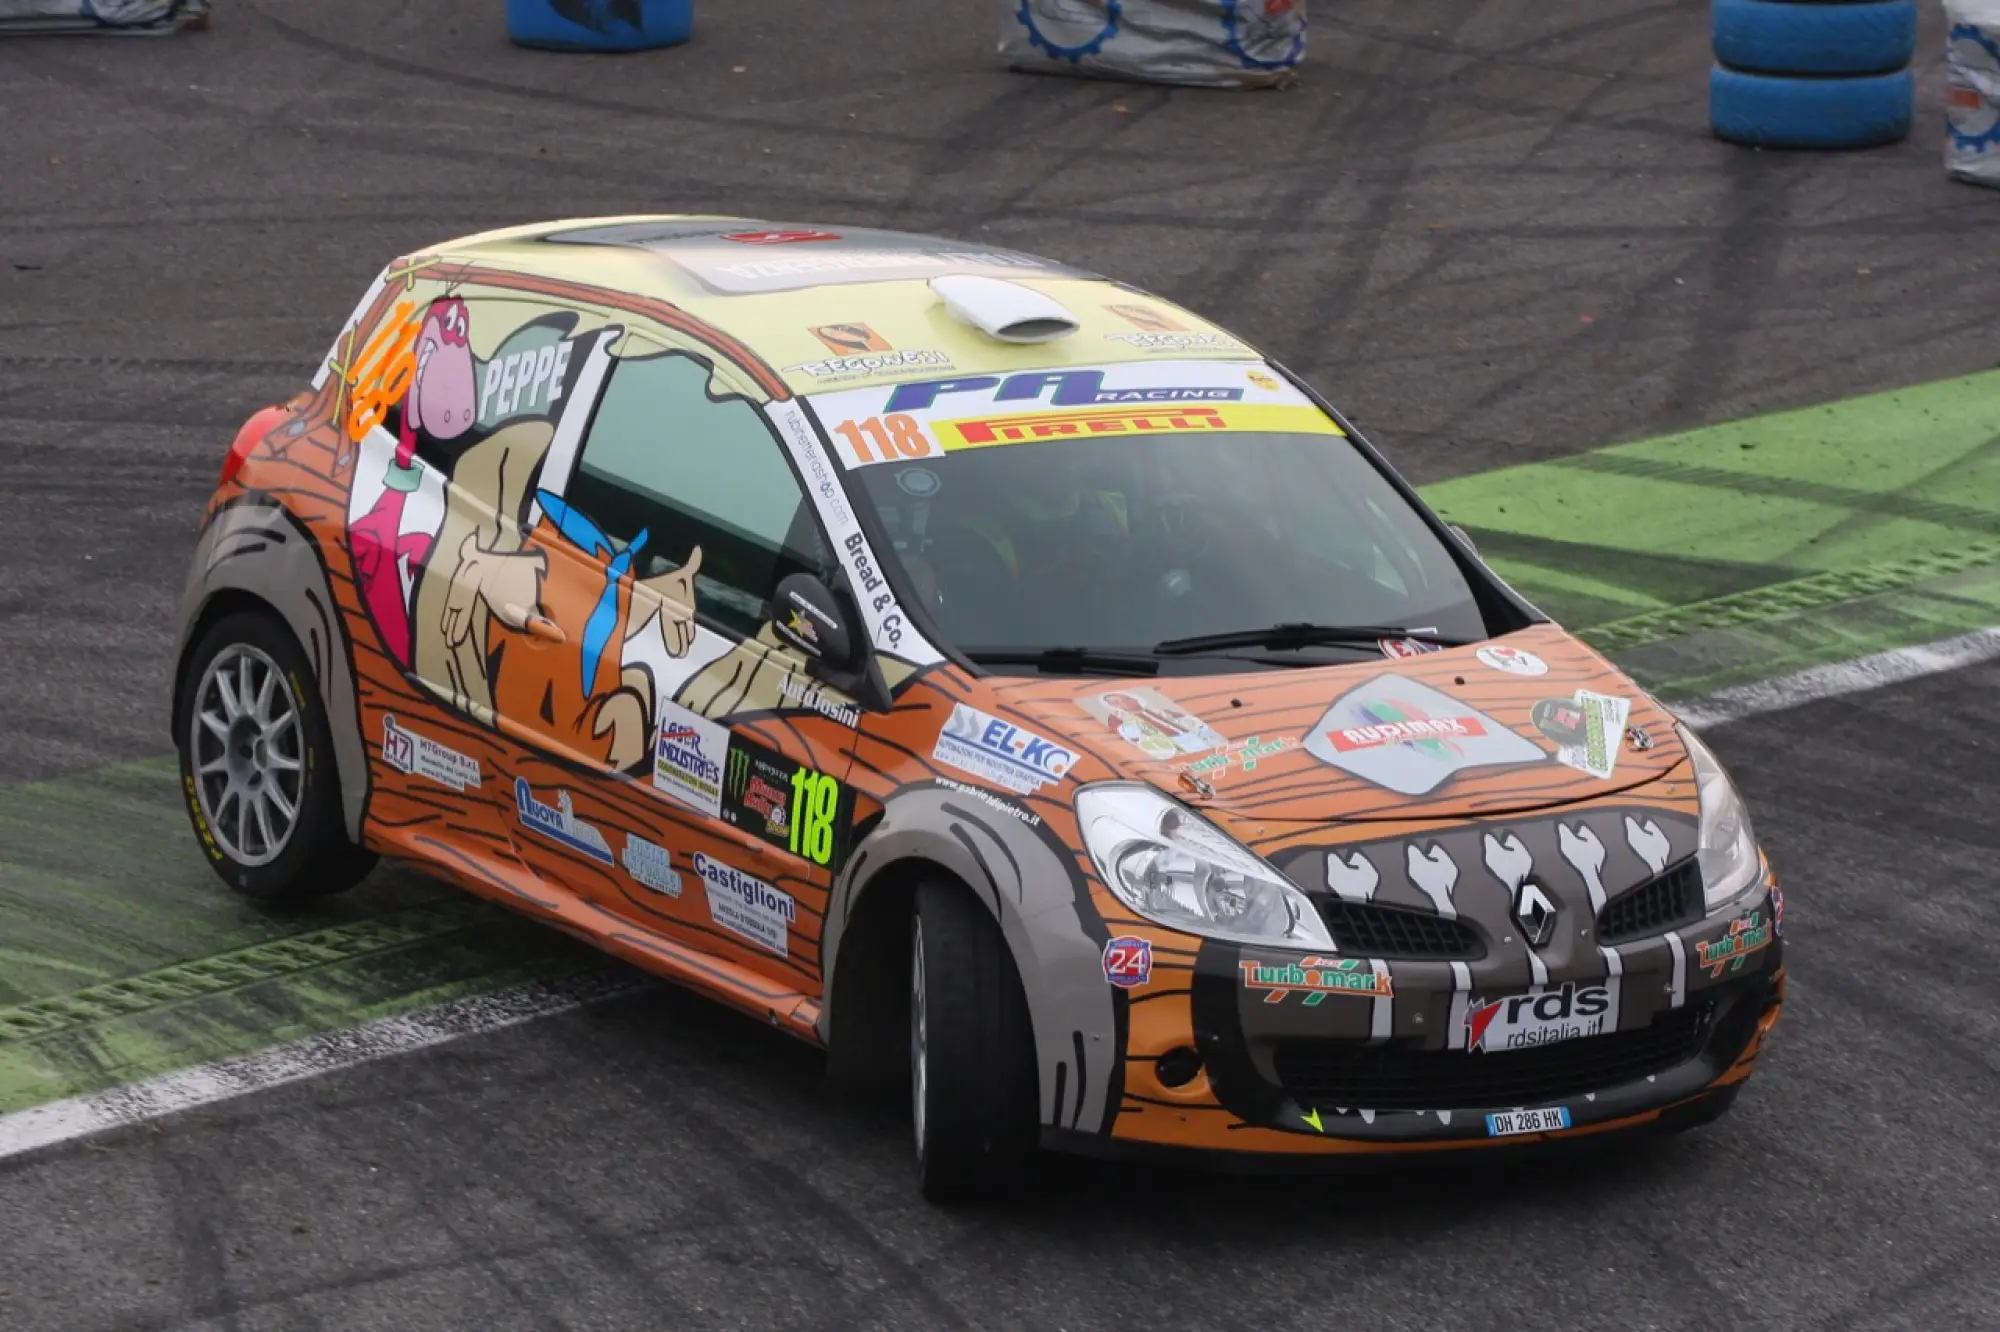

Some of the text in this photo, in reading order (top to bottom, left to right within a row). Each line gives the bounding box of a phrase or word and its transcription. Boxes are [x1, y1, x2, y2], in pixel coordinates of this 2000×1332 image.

[478, 340, 573, 420] PEPPE
[1095, 388, 1230, 402] RACING
[834, 413, 931, 463] 118
[955, 408, 1228, 445] PIRELLI
[844, 531, 903, 650] Bread & Co.
[385, 730, 409, 760] H7
[660, 716, 703, 757] LASER
[658, 740, 720, 785] INDUSTRIES
[790, 766, 838, 865] 118
[694, 853, 795, 921] Castiglioni
[1109, 948, 1146, 975] 24
[1506, 983, 1610, 1025] rds
[1495, 1114, 1514, 1133] DH
[1515, 1111, 1541, 1130] 286
